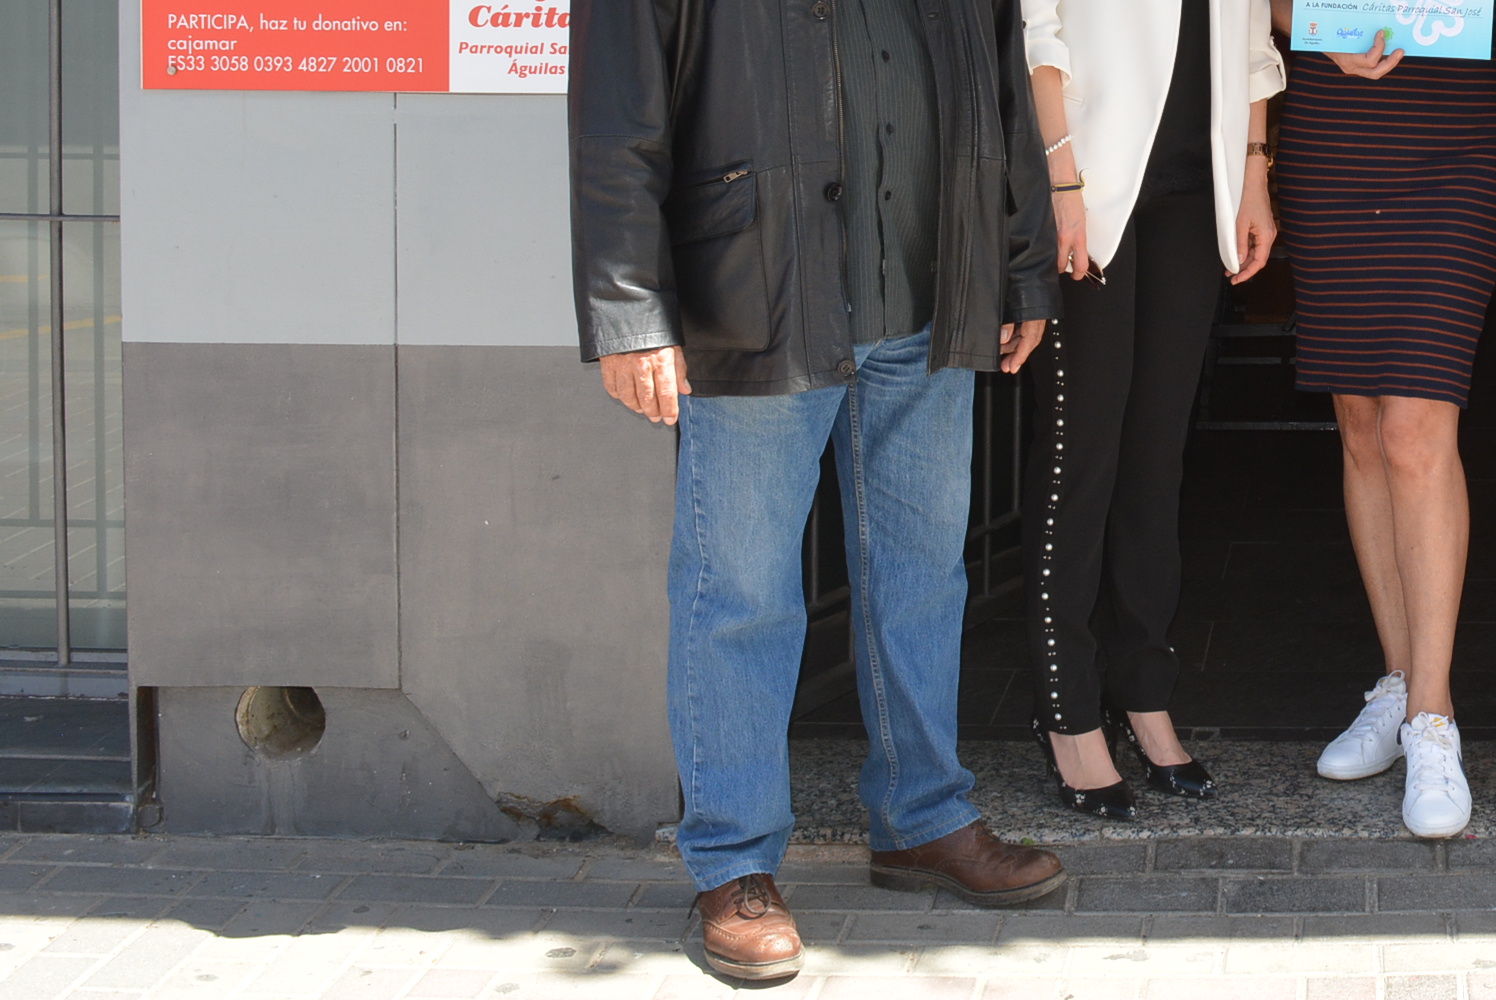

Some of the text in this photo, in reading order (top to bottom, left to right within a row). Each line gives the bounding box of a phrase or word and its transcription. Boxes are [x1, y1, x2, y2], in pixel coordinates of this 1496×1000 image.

[468, 4, 571, 28] Cárita
[1321, 2, 1358, 10] FUNDACIÓN
[1362, 2, 1395, 13] Cáritas
[1397, 3, 1443, 17] Parroquial
[1443, 6, 1463, 16] San
[167, 13, 407, 33] PARTICIPA, haz tu donativo en:
[167, 34, 237, 54] cajamar
[458, 41, 570, 58] Parroquial Sa
[210, 56, 249, 72] 3058
[254, 56, 293, 72] 0393
[298, 56, 337, 73] 4827
[342, 56, 380, 73] 2001
[386, 57, 423, 74] 0821
[507, 59, 566, 78] Águilas
